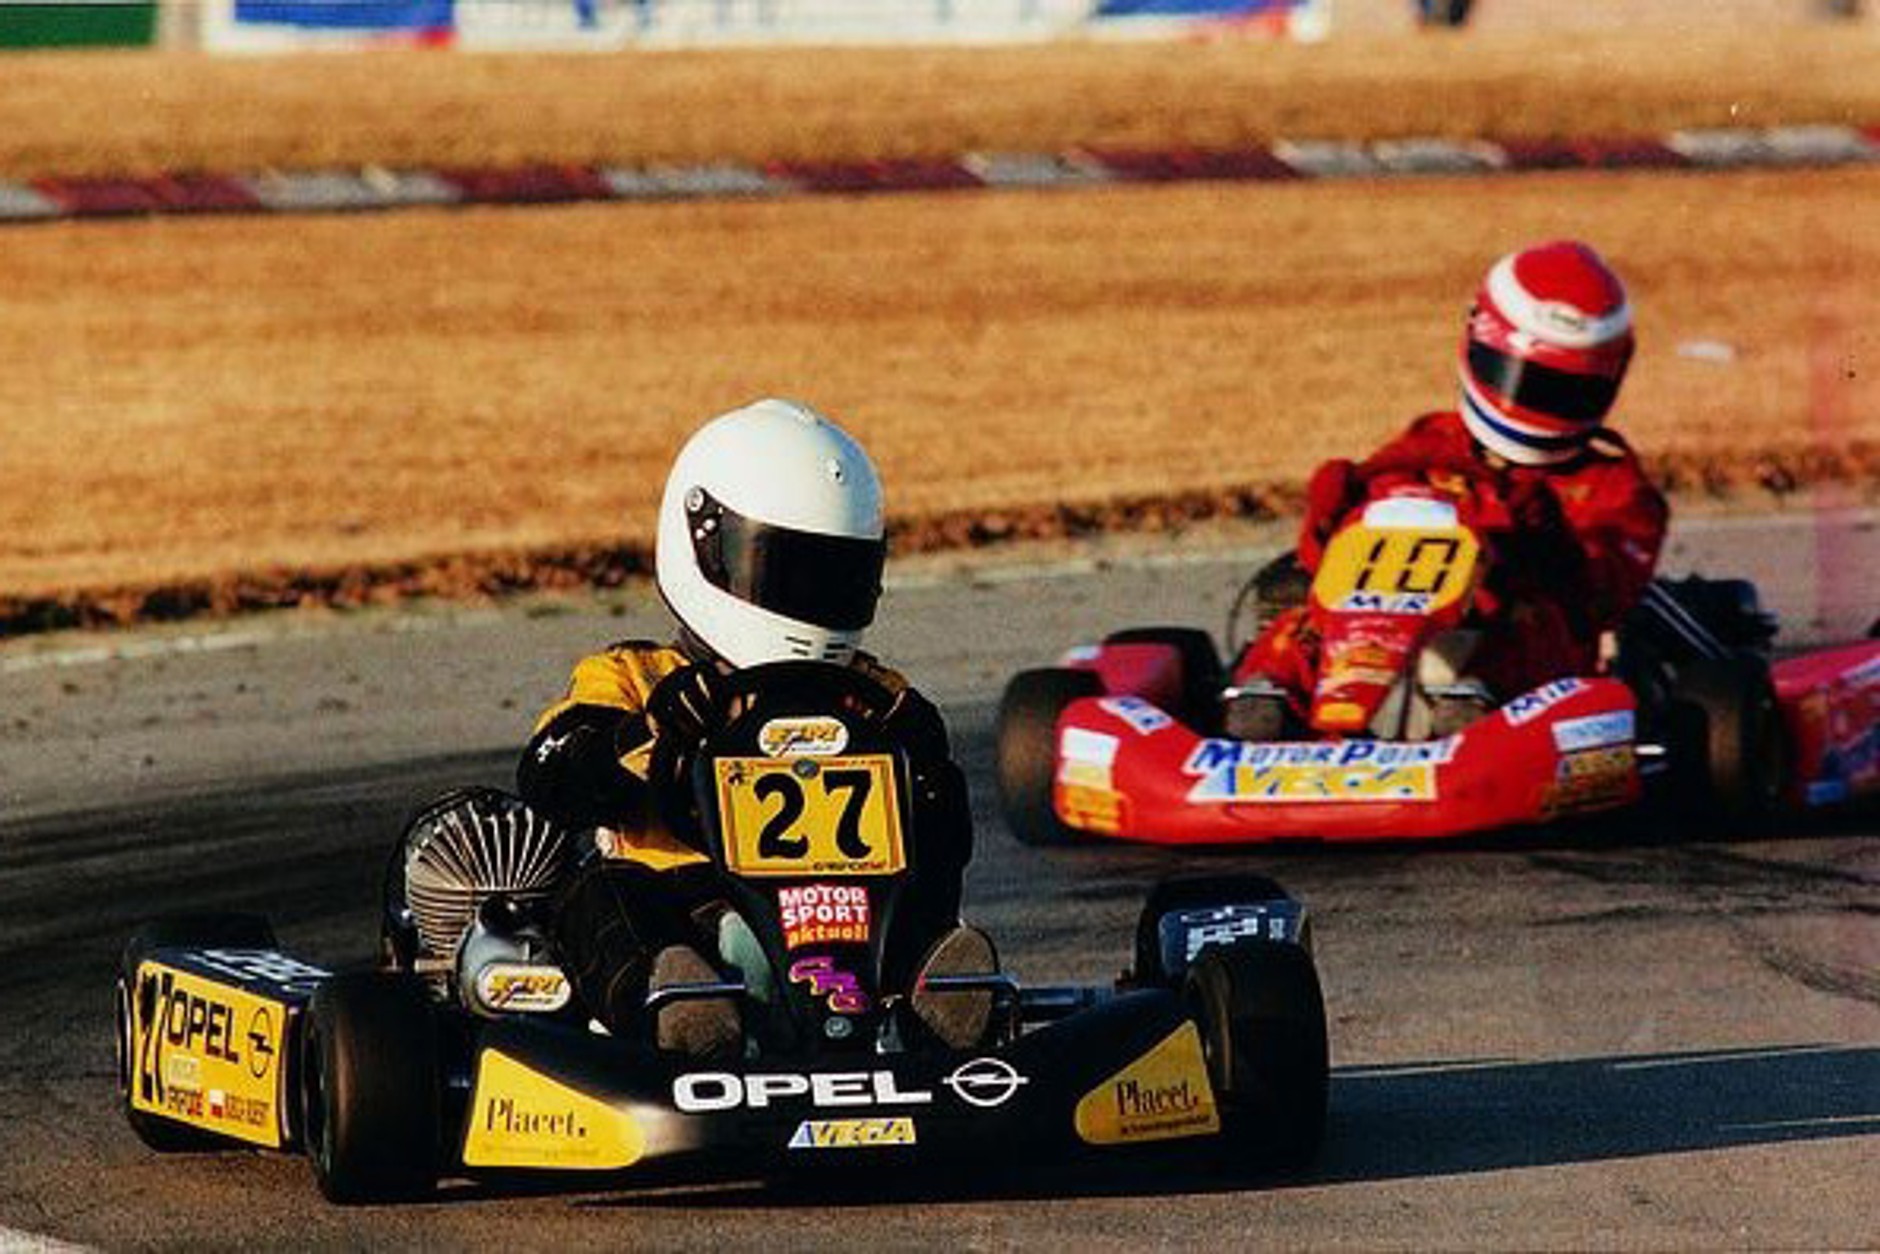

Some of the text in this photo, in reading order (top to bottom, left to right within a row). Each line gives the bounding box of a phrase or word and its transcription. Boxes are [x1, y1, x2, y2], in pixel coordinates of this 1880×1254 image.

[1355, 538, 1460, 593] 10
[753, 769, 872, 860] 27
[778, 886, 866, 908] MOTOR
[782, 904, 868, 928] SPORT
[167, 990, 239, 1064] OPEL
[673, 1071, 932, 1110] OPEL
